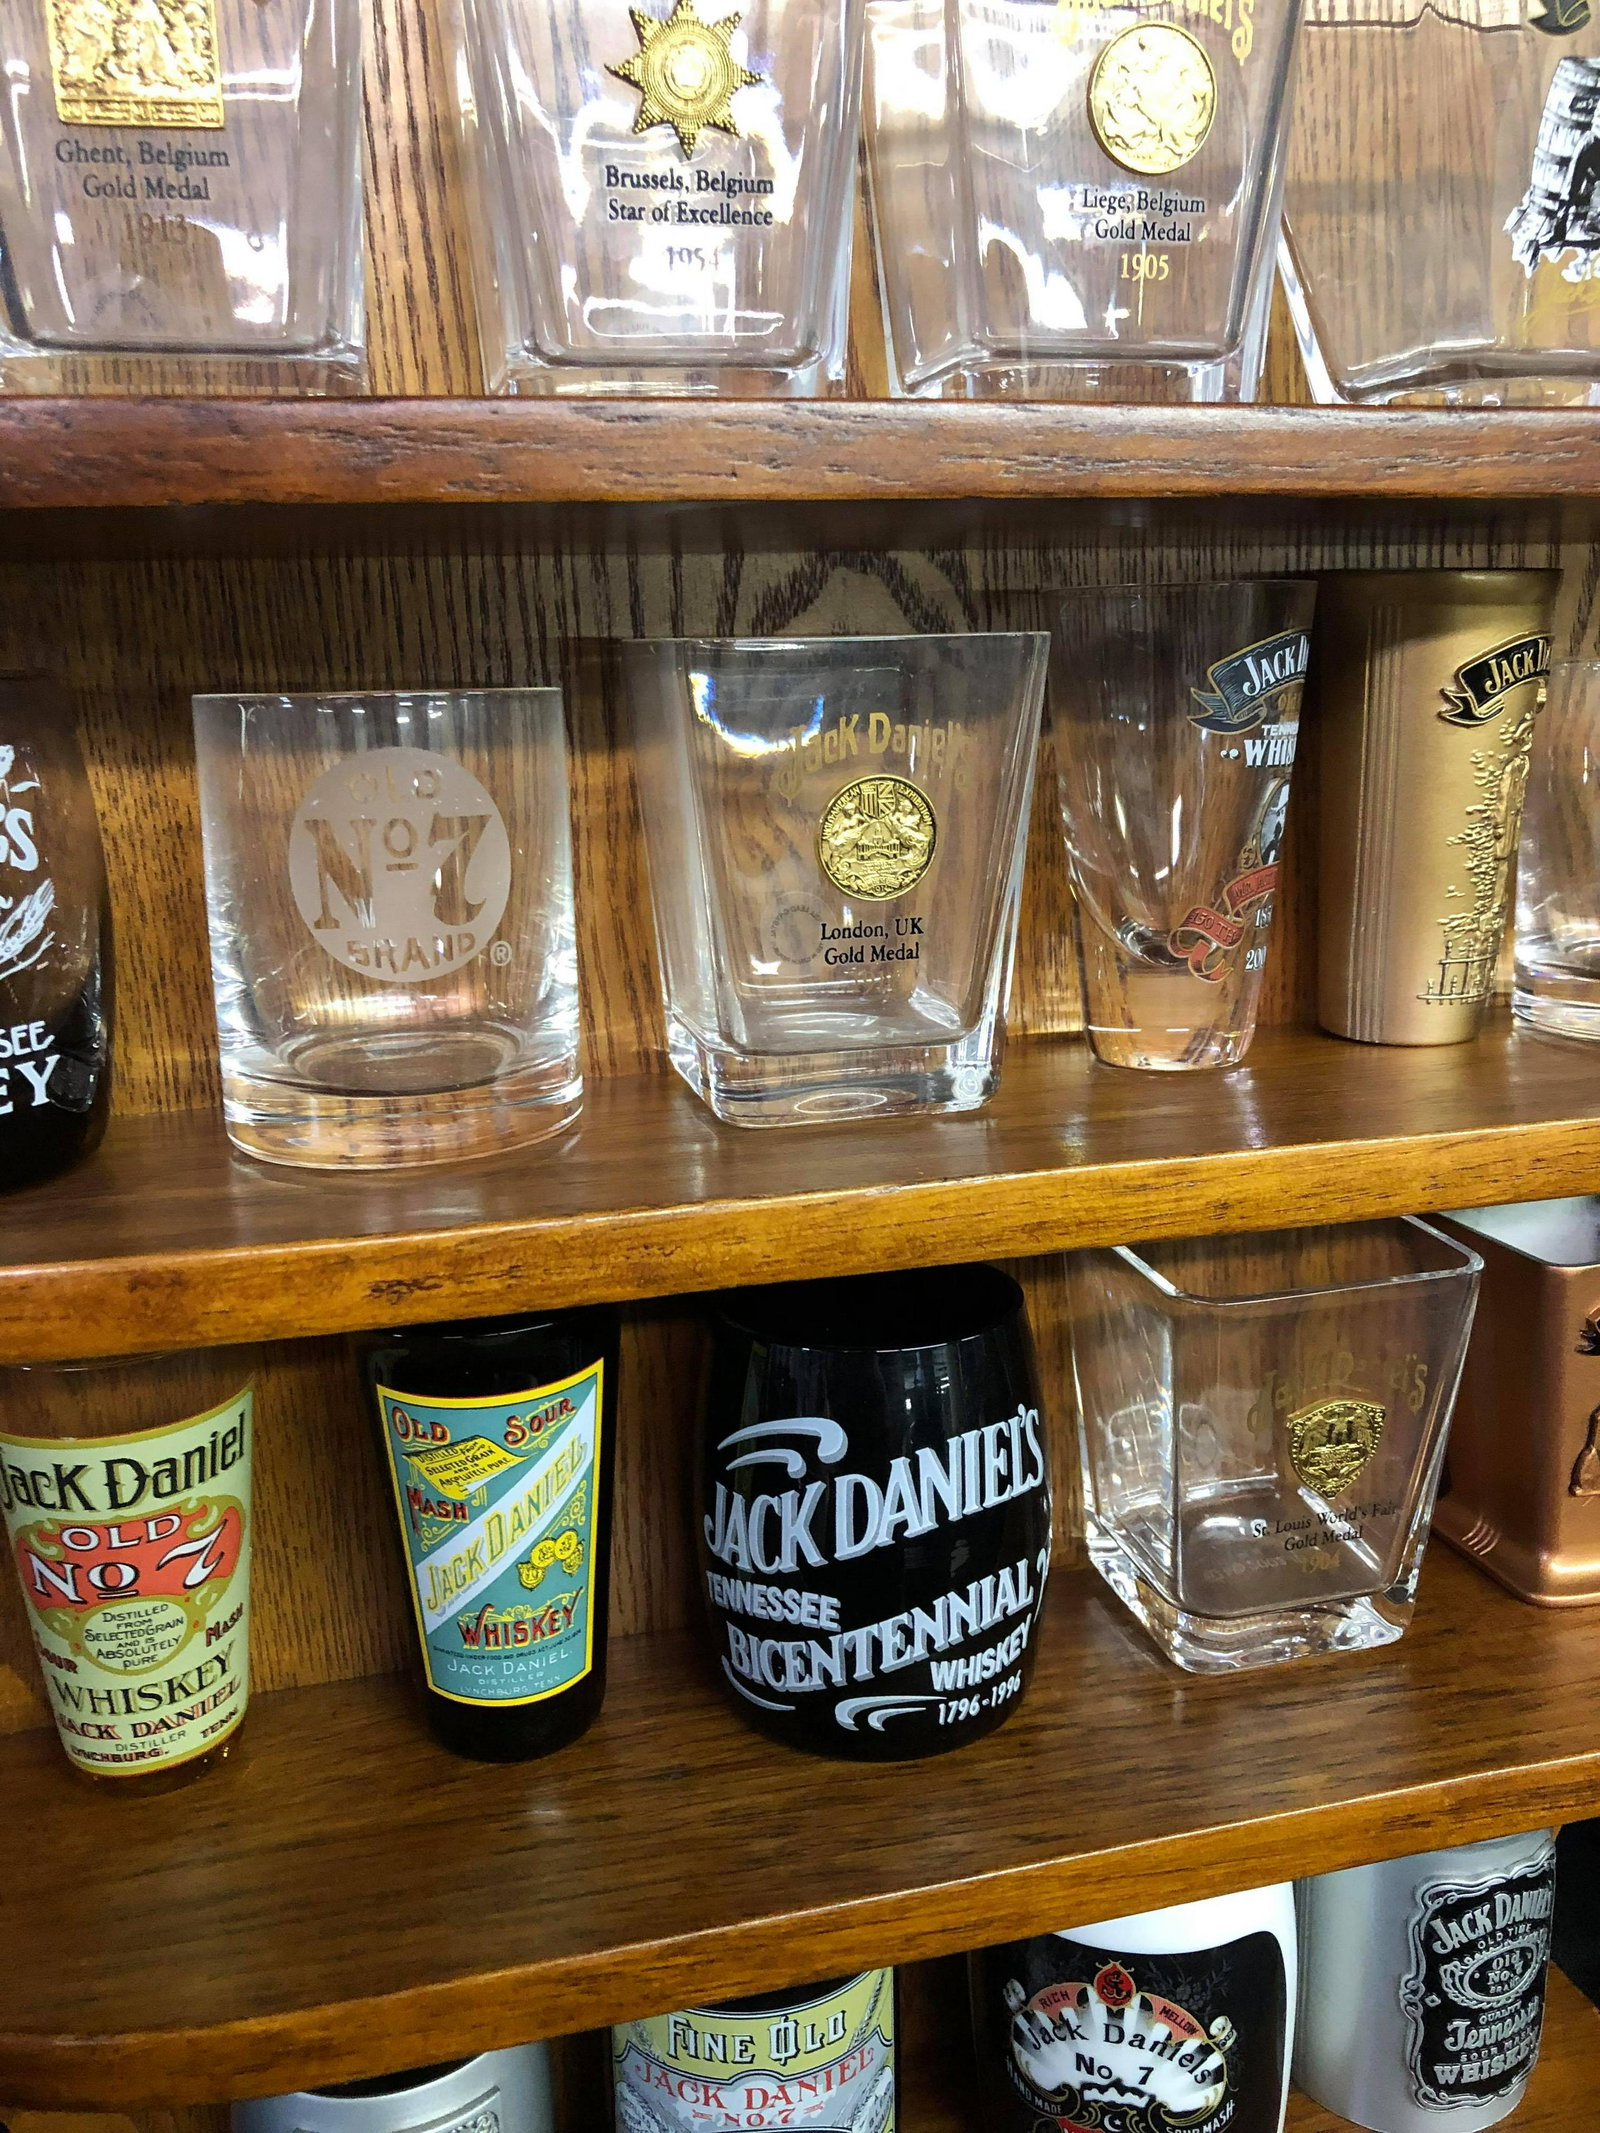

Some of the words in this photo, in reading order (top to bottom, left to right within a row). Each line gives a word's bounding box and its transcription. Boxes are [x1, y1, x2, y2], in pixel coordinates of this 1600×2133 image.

[55, 139, 131, 166] Ghent,
[138, 141, 230, 172] Belgium
[83, 174, 136, 200] Gold
[145, 176, 211, 201] Medal
[605, 164, 690, 193] Brussels,
[695, 169, 774, 199] Belgium
[608, 198, 646, 222] Star
[651, 200, 671, 222] of
[676, 201, 773, 226] Excellence
[1082, 189, 1132, 215] Liege,
[1137, 190, 1206, 217] Belgium
[1095, 219, 1136, 241] Gold
[1141, 221, 1192, 242] Medal
[1121, 253, 1170, 282] 1905
[1242, 645, 1297, 697] JACK
[1484, 648, 1535, 695] JACK
[820, 919, 890, 941] London,
[895, 917, 925, 936] UK
[824, 946, 868, 966] Gold
[871, 942, 921, 963] Medal
[391, 1405, 451, 1445] OLD
[503, 1397, 577, 1447] SOUR
[100, 1408, 247, 1511] Daniel
[416, 1447, 459, 1464] DISTILLED
[703, 1478, 830, 1576] JACK
[833, 1402, 1046, 1563] DANIEL'S
[406, 1484, 470, 1537] MASH
[425, 1536, 492, 1613] JACK
[482, 1432, 588, 1566] DANIEL
[1252, 1523, 1271, 1538] St.
[1275, 1516, 1312, 1535] Louis
[1316, 1505, 1368, 1527] World's
[1371, 1501, 1398, 1518] Fair
[60, 1513, 182, 1552] OLD
[1284, 1533, 1318, 1553] Gold
[1321, 1525, 1363, 1546] Medal
[155, 1519, 229, 1590] 7
[101, 1603, 169, 1623] DISTILLED
[456, 1586, 584, 1651] WHISKEY
[706, 1570, 841, 1632] TENNESSEE
[84, 1627, 147, 1643] SELECTED
[145, 1616, 185, 1636] GRAIN
[116, 1618, 153, 1630] FROM
[205, 1602, 244, 1648] MASH
[724, 1557, 1036, 1693] BICENTENNIAL
[95, 1635, 182, 1660] ABSOLUTELY
[116, 1640, 140, 1649] AND
[122, 1653, 159, 1670] PURE
[929, 1612, 1033, 1692] WHISKEY
[50, 1639, 236, 1717] WHISKEY
[447, 1658, 496, 1676] JACK
[478, 1671, 546, 1686] DISTILLER
[130, 1674, 242, 1740] DANIEL
[937, 1668, 1023, 1726] 1796-1996
[114, 1730, 187, 1753] DISTILLER
[1429, 1902, 1494, 1955] JACK
[1477, 1932, 1504, 1950] OLD
[1508, 1923, 1532, 1940] TIME
[1492, 1949, 1521, 1971] Old
[1037, 1989, 1072, 2011] RICH
[1159, 2004, 1200, 2037] MELLOW
[1479, 1999, 1522, 2025] QUALITY
[667, 2012, 756, 2065] FINE
[768, 2009, 849, 2067] OLD
[1027, 2017, 1090, 2052] Jack
[1103, 2022, 1212, 2085] Daniels
[1433, 2024, 1540, 2085] WHISKEY
[1460, 2046, 1499, 2063] SOUR
[634, 2060, 727, 2110] JACK
[744, 2046, 876, 2111] DANIEL
[1075, 2052, 1113, 2080] No
[1137, 2065, 1155, 2086] 7
